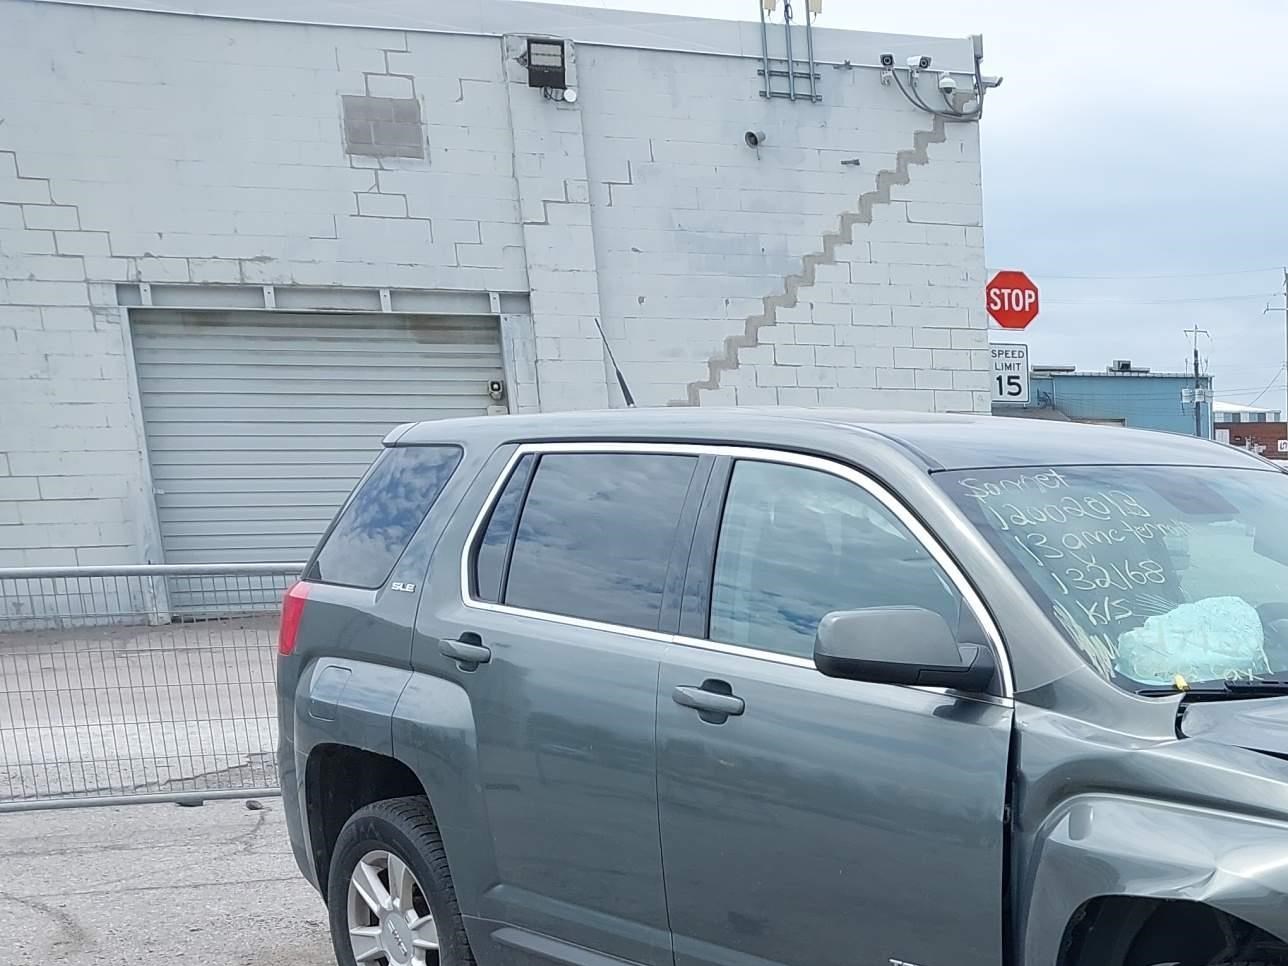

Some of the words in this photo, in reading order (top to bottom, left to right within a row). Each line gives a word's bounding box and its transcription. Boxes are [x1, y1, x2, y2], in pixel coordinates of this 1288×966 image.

[989, 288, 1036, 312] STOP
[991, 349, 1025, 359] SPEED
[994, 362, 1021, 371] LIMIT
[996, 375, 1022, 396] 15
[988, 490, 1151, 530] 12002013
[1015, 533, 1063, 566] 13
[391, 582, 416, 592] SLE
[1052, 560, 1166, 595] 132168
